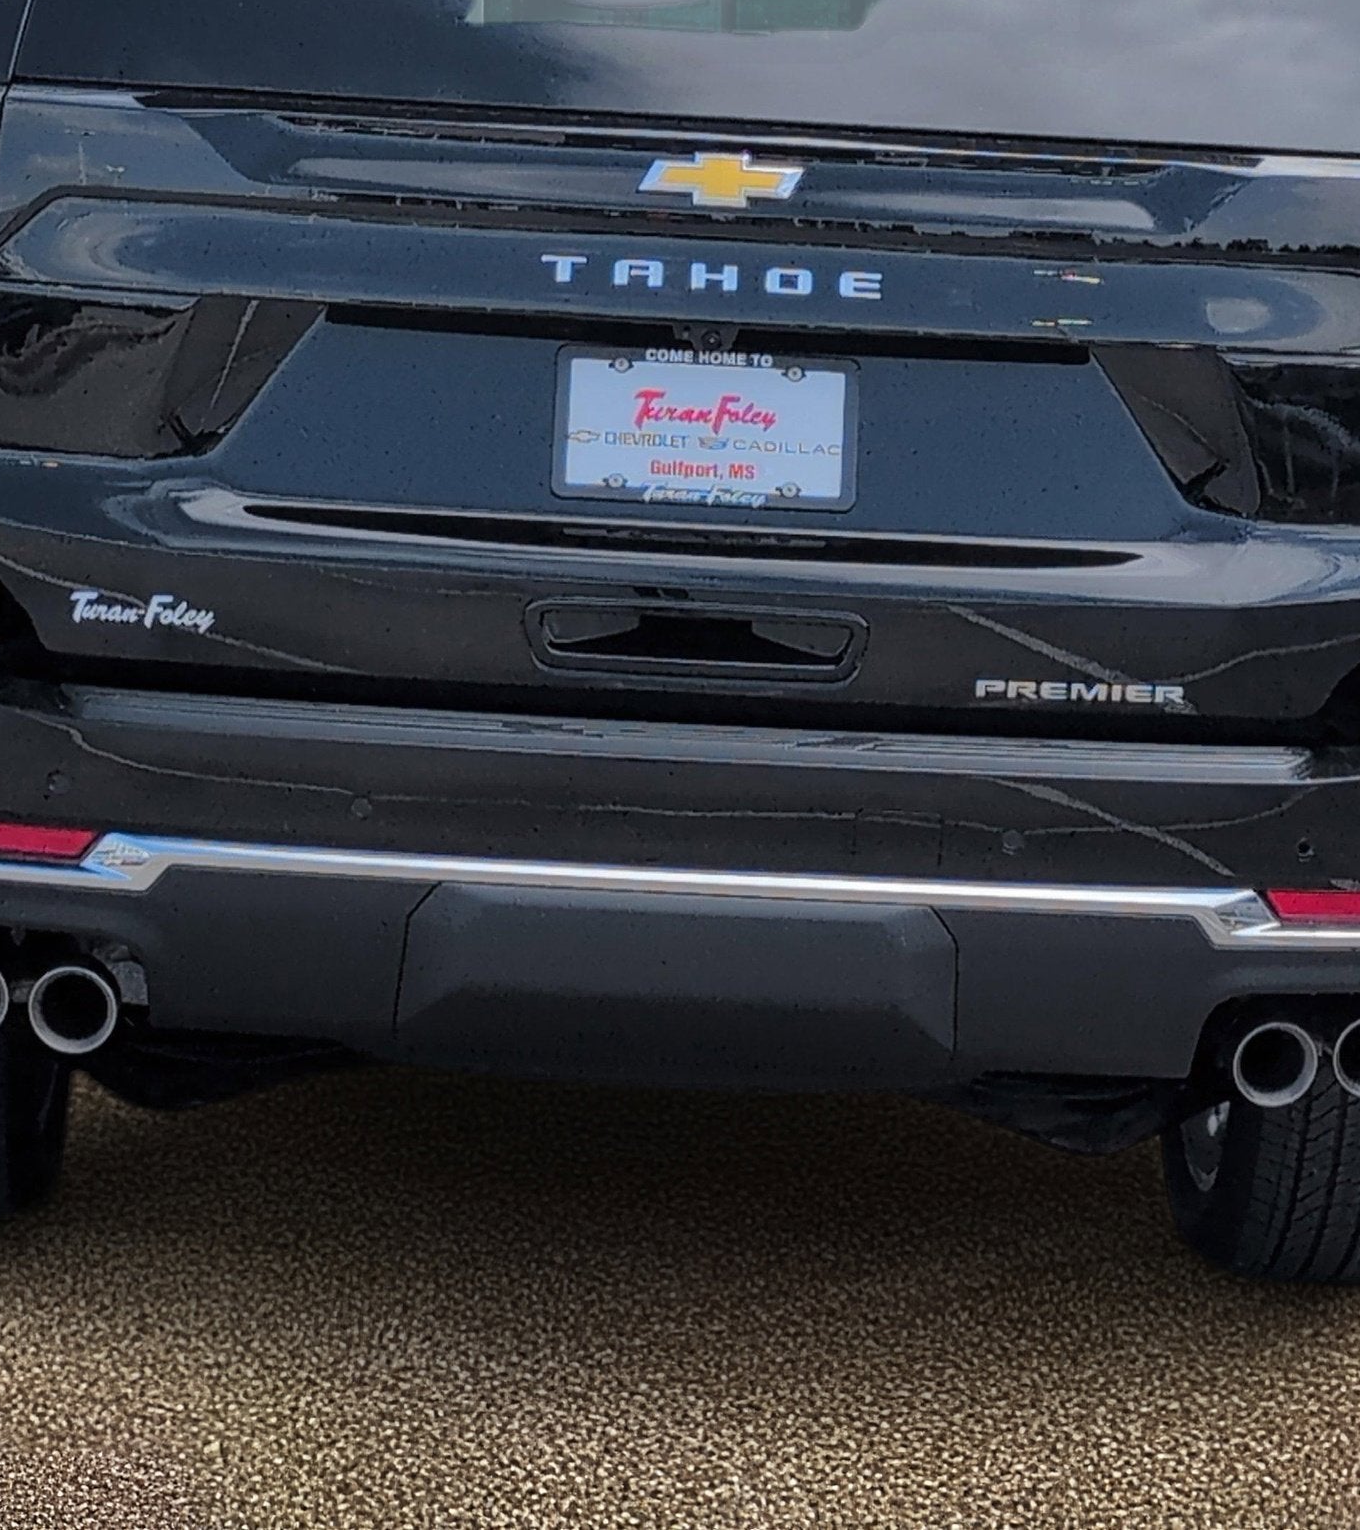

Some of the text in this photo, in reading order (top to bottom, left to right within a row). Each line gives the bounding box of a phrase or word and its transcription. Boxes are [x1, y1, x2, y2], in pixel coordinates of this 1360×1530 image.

[541, 254, 883, 300] TAHOE
[645, 348, 773, 368] COME HOME TO
[604, 431, 840, 456] CHEVROLET CADILLAC
[649, 458, 756, 481] Gulfport, MS
[974, 679, 1185, 704] PREMIER
